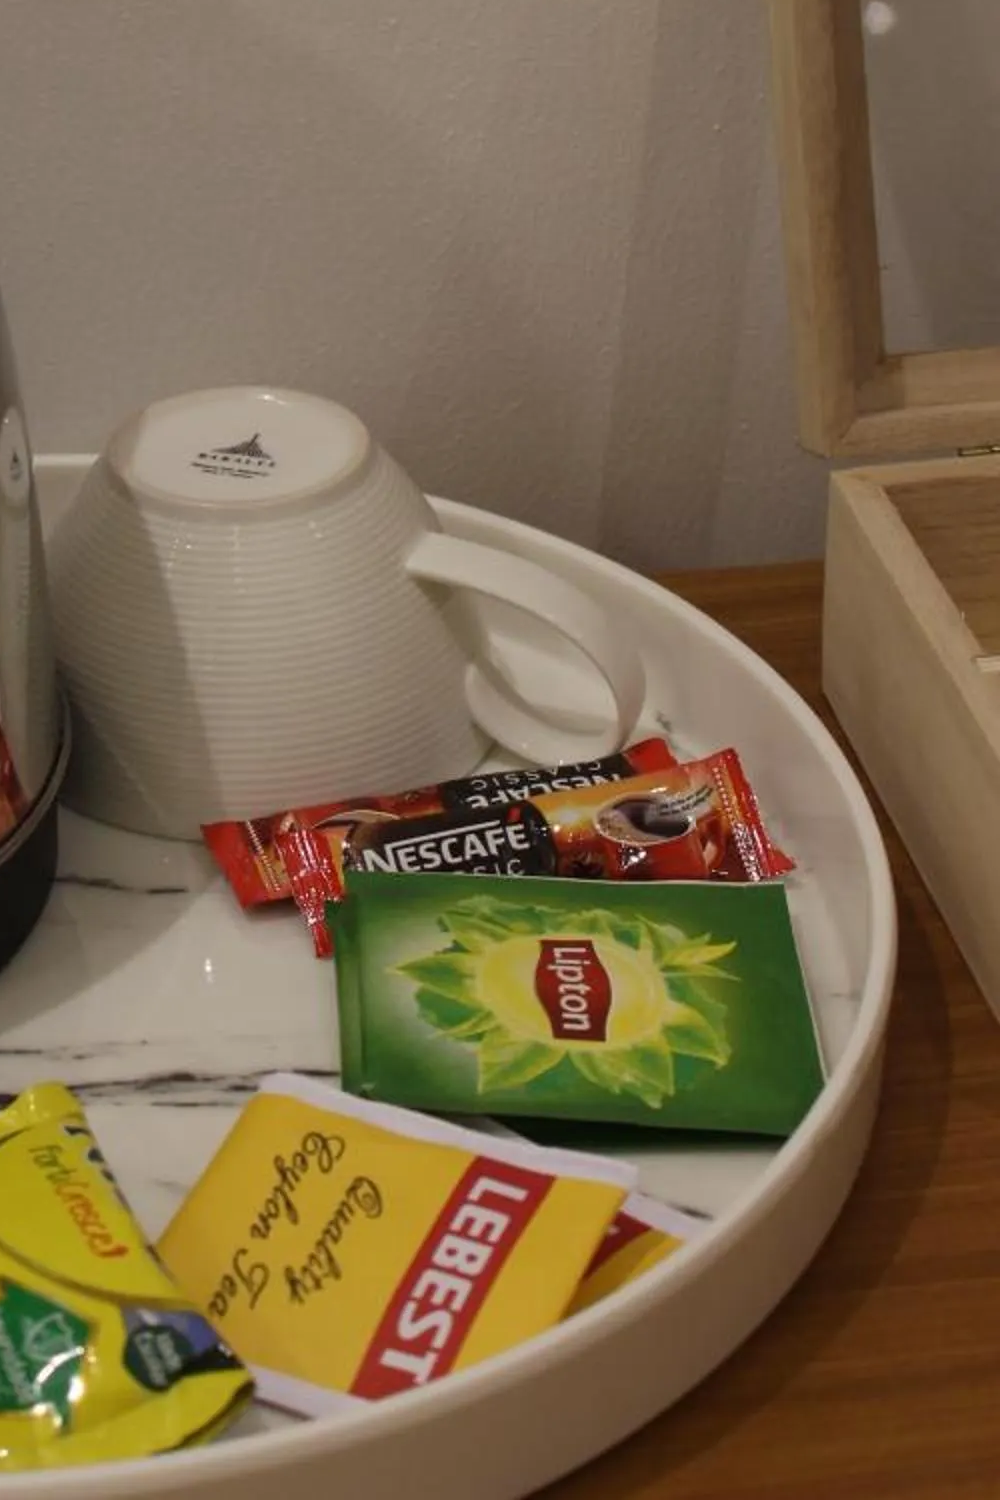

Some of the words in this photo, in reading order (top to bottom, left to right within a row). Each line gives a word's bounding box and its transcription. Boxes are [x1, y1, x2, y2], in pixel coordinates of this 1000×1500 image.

[546, 947, 591, 1030] Lipton
[250, 1131, 346, 1240] Ceylon
[208, 1247, 270, 1317] Tea
[284, 1175, 384, 1306] Quality
[380, 1175, 530, 1385] LEBEST
